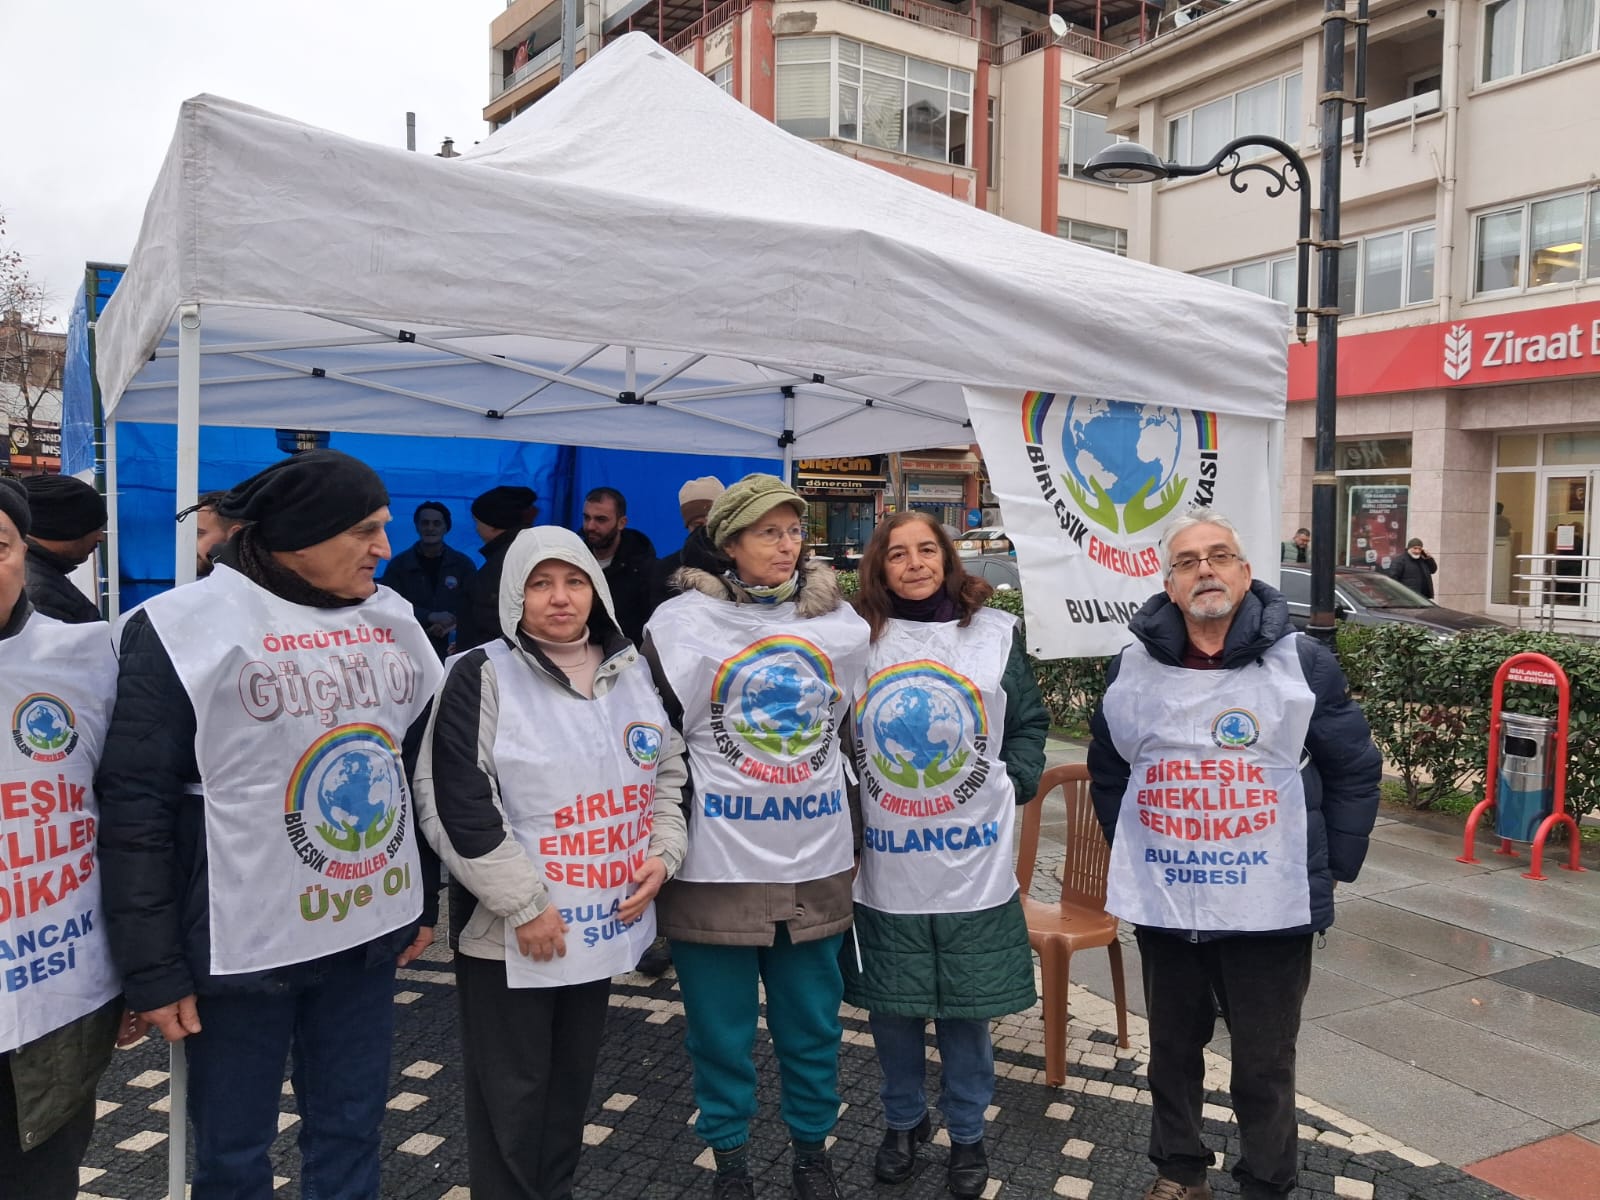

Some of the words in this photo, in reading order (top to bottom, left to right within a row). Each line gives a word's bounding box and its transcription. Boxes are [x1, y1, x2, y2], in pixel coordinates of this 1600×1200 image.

[1481, 323, 1584, 368] Ziraat
[805, 480, 863, 488] dönercim
[1088, 535, 1161, 577] EMEKLİLER
[1065, 598, 1144, 624] BULANC
[263, 624, 371, 652] ÖRGÜTLÜ
[373, 627, 396, 644] OL
[1509, 667, 1555, 679] BULANCAK
[238, 653, 381, 728] Güçlü
[739, 757, 813, 784] EMEKLİLER
[880, 792, 956, 817] EMEKLİLER
[953, 735, 990, 805] SENDİKSI
[1145, 757, 1265, 787] BİRLEŞİK
[0, 774, 86, 826] EŞİK
[554, 779, 656, 830] BİRLEŞİ
[704, 789, 842, 821] BULANCAK
[1137, 786, 1279, 811] EMEKLİLER
[284, 812, 328, 872] BİRLEŞİK
[325, 852, 388, 880] EMEKLİLER
[386, 787, 407, 859] SENDİKASI
[1139, 809, 1277, 841] SENDİKASI
[0, 817, 96, 872] LİLER
[1144, 848, 1269, 865] BULANCAK
[299, 884, 373, 922] Üye
[383, 862, 411, 896] Ol
[1164, 867, 1248, 887] ŞUBESİ
[558, 896, 629, 924] BULA
[0, 942, 76, 993] BESİ
